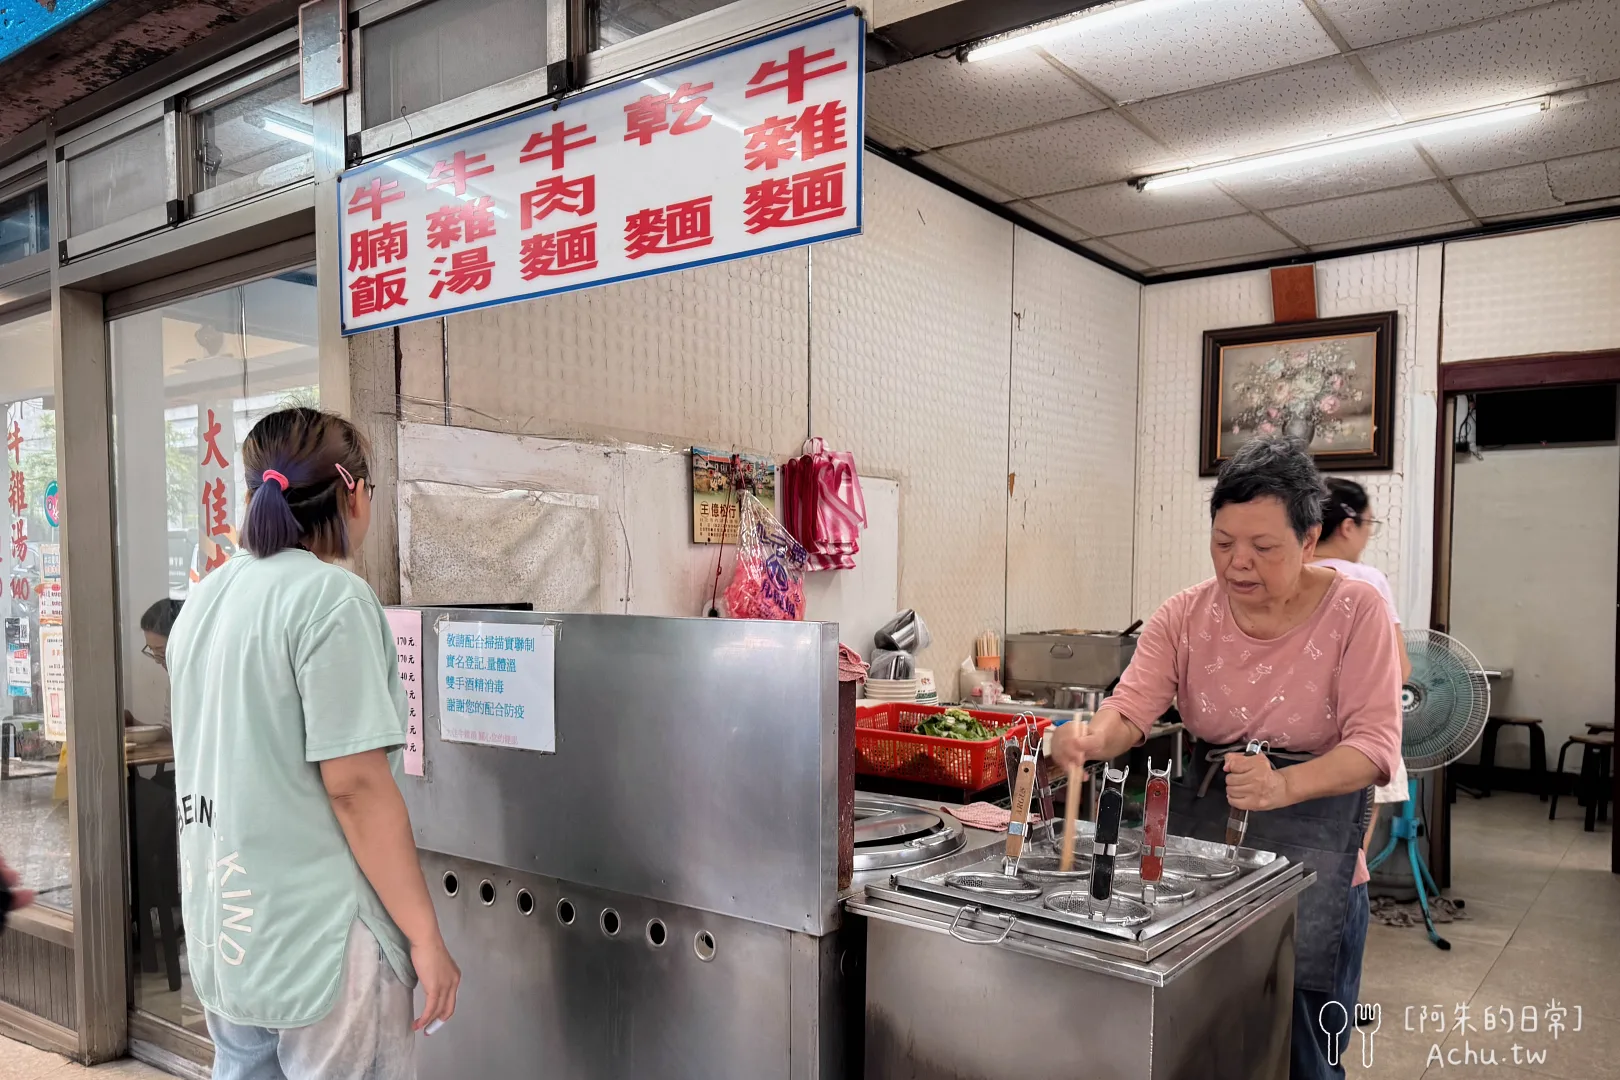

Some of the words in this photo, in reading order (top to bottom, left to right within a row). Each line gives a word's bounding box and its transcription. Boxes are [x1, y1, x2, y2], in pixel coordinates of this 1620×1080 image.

[520, 121, 598, 282] 牛肉麵
[744, 46, 847, 235] 牛雜麵
[348, 178, 408, 318] 牛腩飯
[427, 150, 496, 300] 牛雜湯
[8, 421, 28, 562] 牛雜湯
[10, 577, 29, 600] 140
[446, 633, 535, 652] 敬請配合掃描實聯制
[445, 675, 504, 694] 雙手酒精消毒
[446, 697, 525, 719] 謝謝您的配合防疫
[217, 851, 254, 966] KIND
